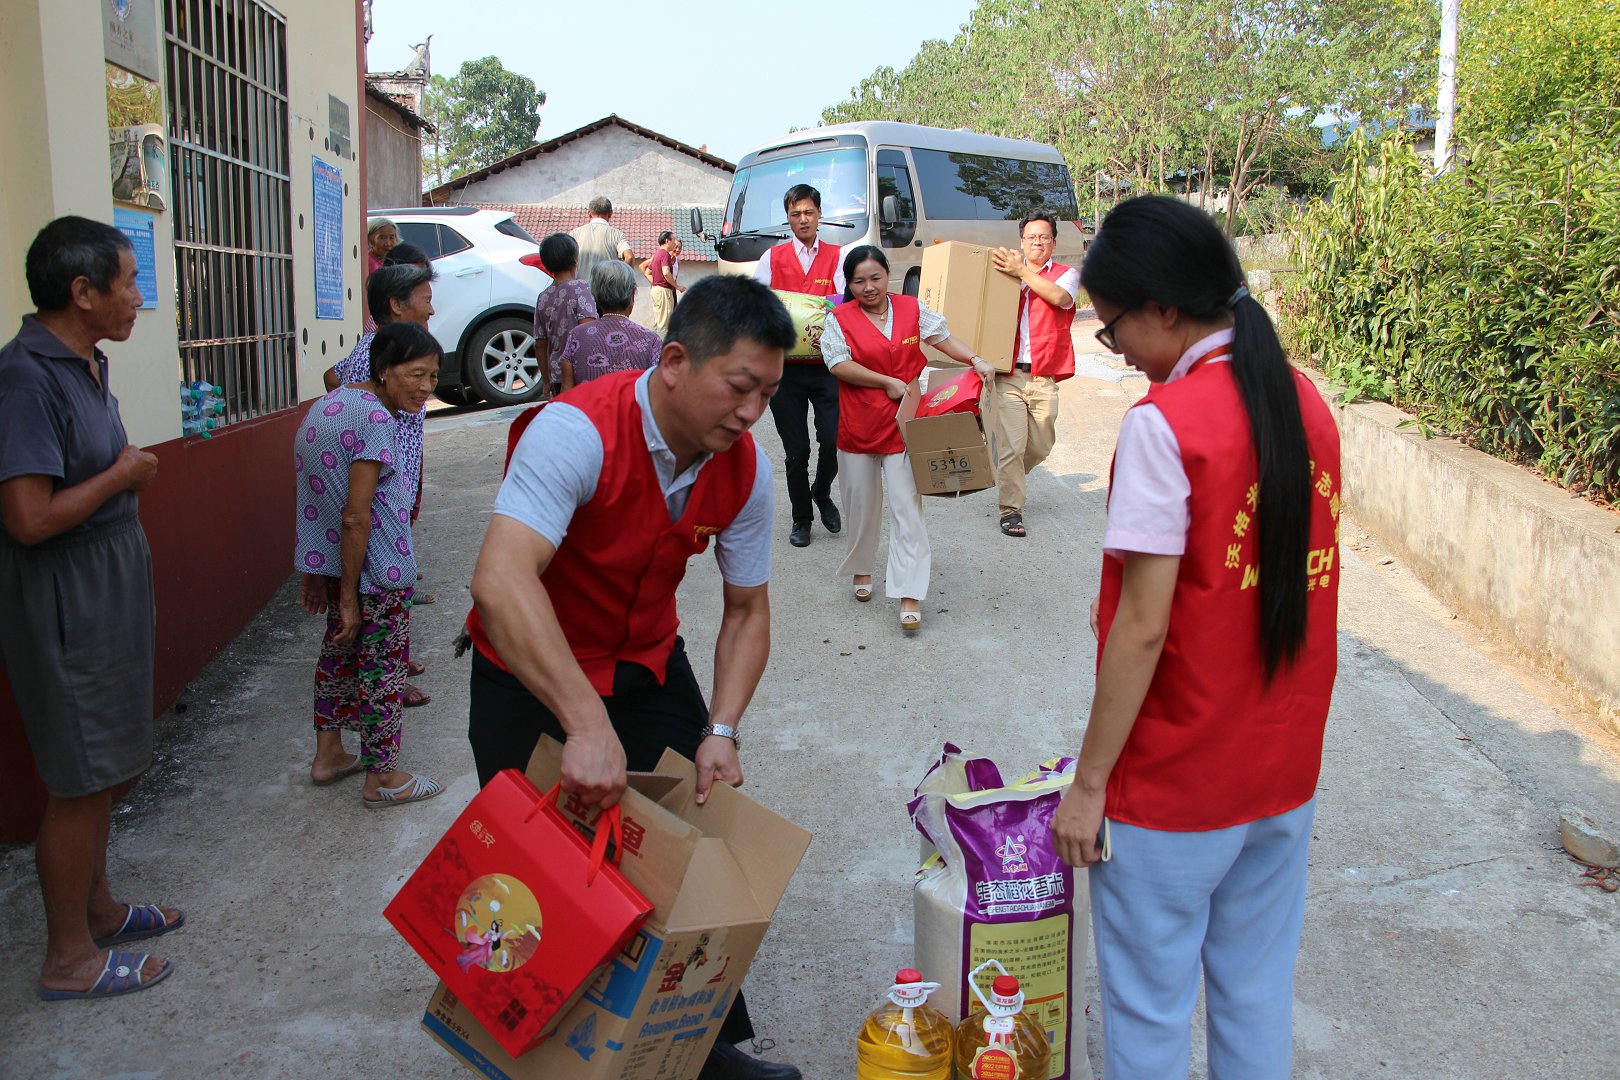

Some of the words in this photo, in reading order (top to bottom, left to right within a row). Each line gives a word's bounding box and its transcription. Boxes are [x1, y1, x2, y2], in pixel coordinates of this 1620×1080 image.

[976, 873, 1065, 904] 生态稻花香米
